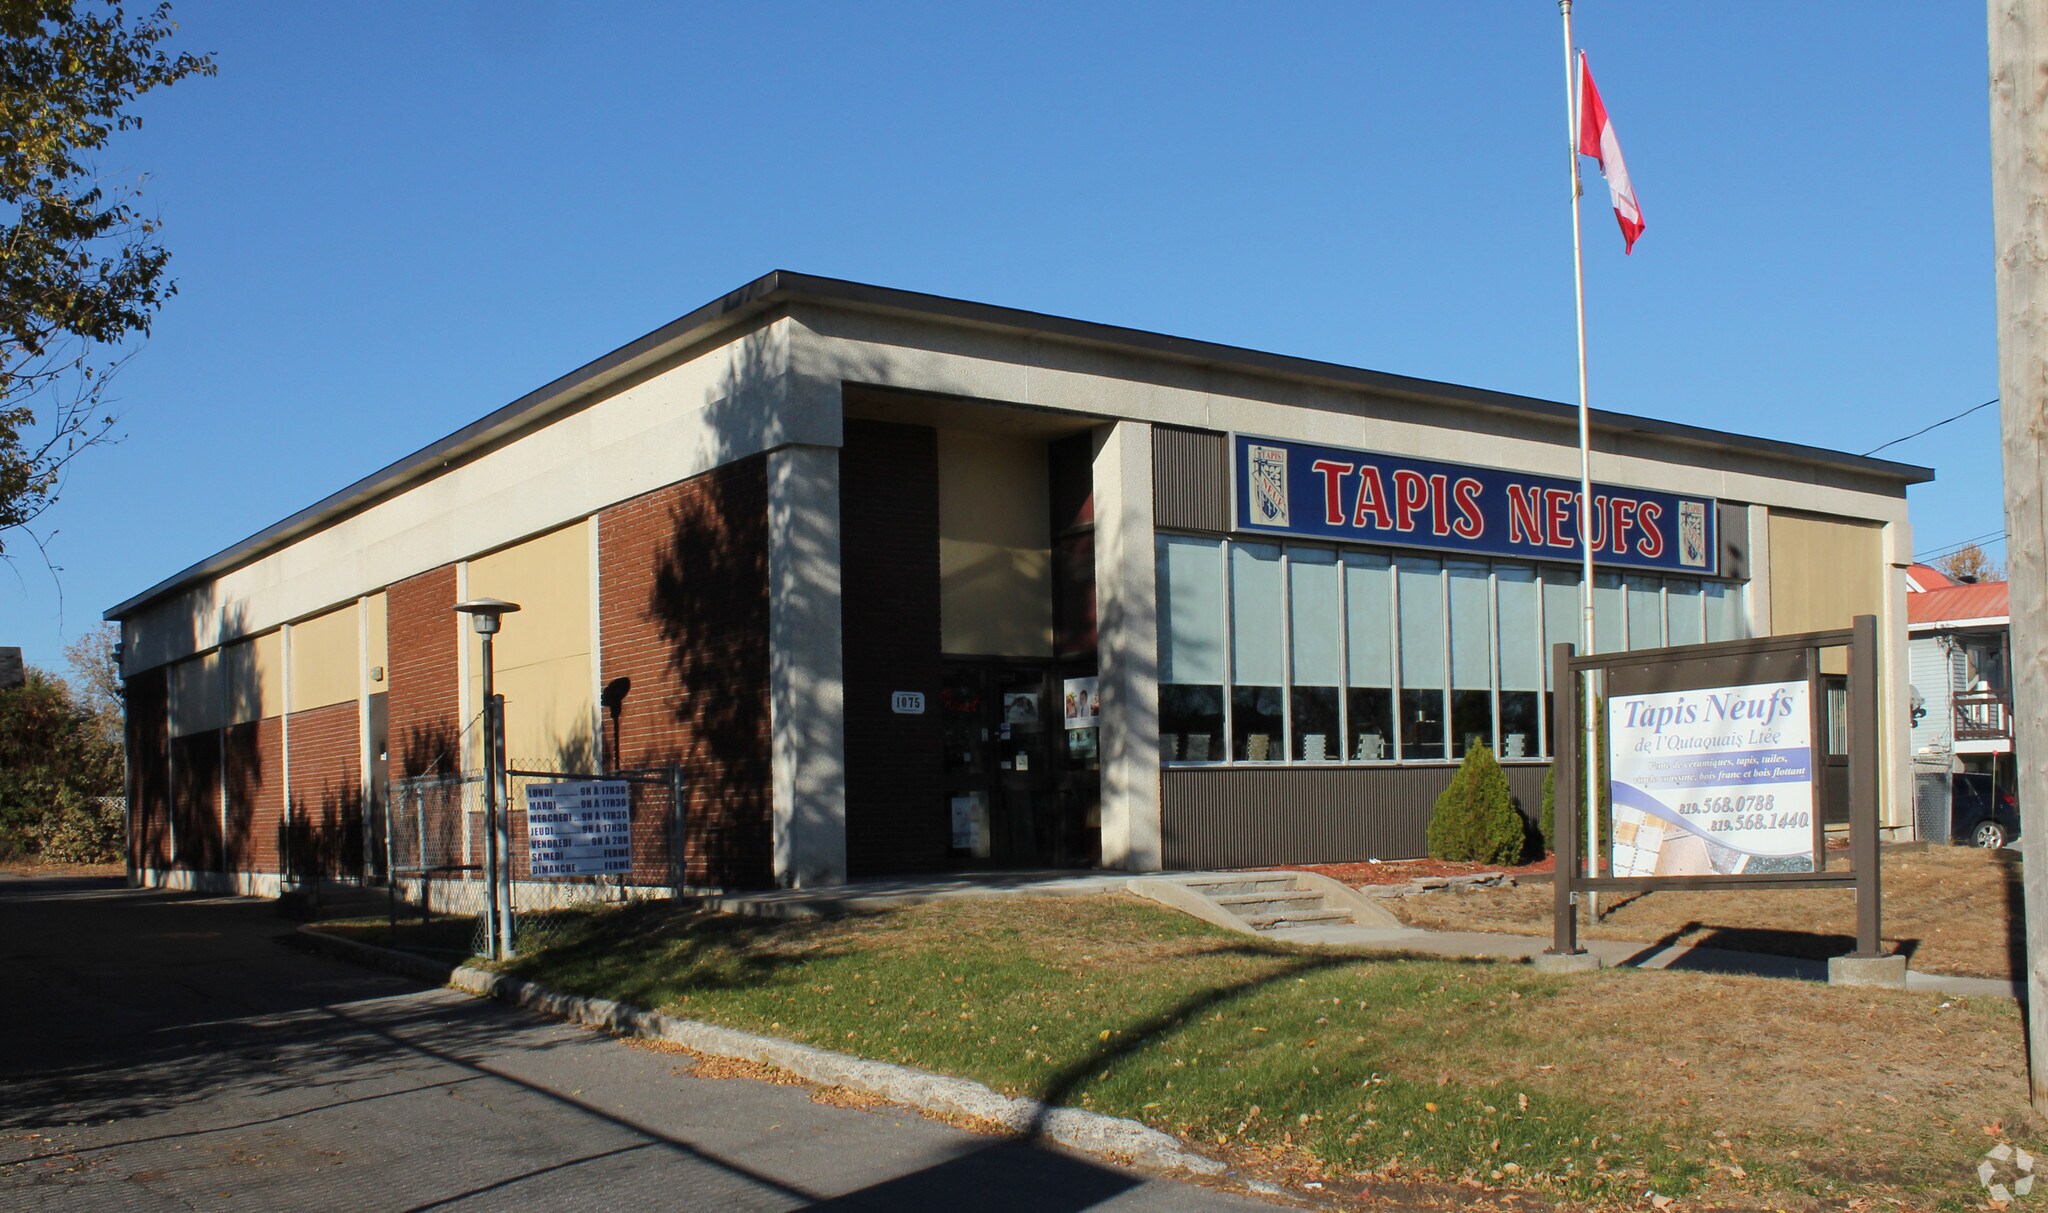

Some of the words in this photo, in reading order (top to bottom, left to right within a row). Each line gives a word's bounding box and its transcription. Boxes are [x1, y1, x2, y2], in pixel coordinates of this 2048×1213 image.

[1262, 478, 1284, 506] NEUF
[1311, 459, 1484, 539] TAPIS
[1506, 484, 1663, 558] NEUFS
[896, 696, 920, 708] 1075
[1624, 697, 1697, 734] Tapis
[1704, 688, 1793, 726] Neufs
[1634, 737, 1652, 752] de
[1748, 728, 1781, 745] Ltée
[1672, 760, 1682, 769] de
[1684, 758, 1734, 770] céramiques,
[1736, 756, 1760, 767] tapis,
[1761, 754, 1788, 764] tuiles,
[1699, 772, 1716, 780] bois
[1716, 771, 1742, 782] franc
[1743, 770, 1751, 778] et
[1753, 768, 1771, 778] bois
[1771, 768, 1806, 778] flottant
[528, 789, 553, 797] LUNDI
[581, 787, 591, 795] 9H
[602, 786, 626, 794] 17H30
[530, 801, 556, 810] MARDI
[581, 800, 592, 808] 9H
[602, 799, 626, 807] 17H30
[1679, 794, 1775, 815] 819.568.0788
[530, 813, 572, 823] MERCREDI
[582, 812, 592, 821] 9H
[603, 811, 627, 820] 17H30
[1710, 812, 1809, 832] 819.568.1440
[531, 827, 553, 836] JEUDI
[583, 825, 593, 833] 9H
[604, 824, 627, 832] 17H30
[531, 839, 572, 848] VENDREDI
[592, 837, 602, 846] 9H
[613, 836, 628, 845] 20H
[532, 852, 563, 861] SAMEDI
[604, 848, 629, 857] FERMÉ
[532, 864, 576, 874] DIMANCHE
